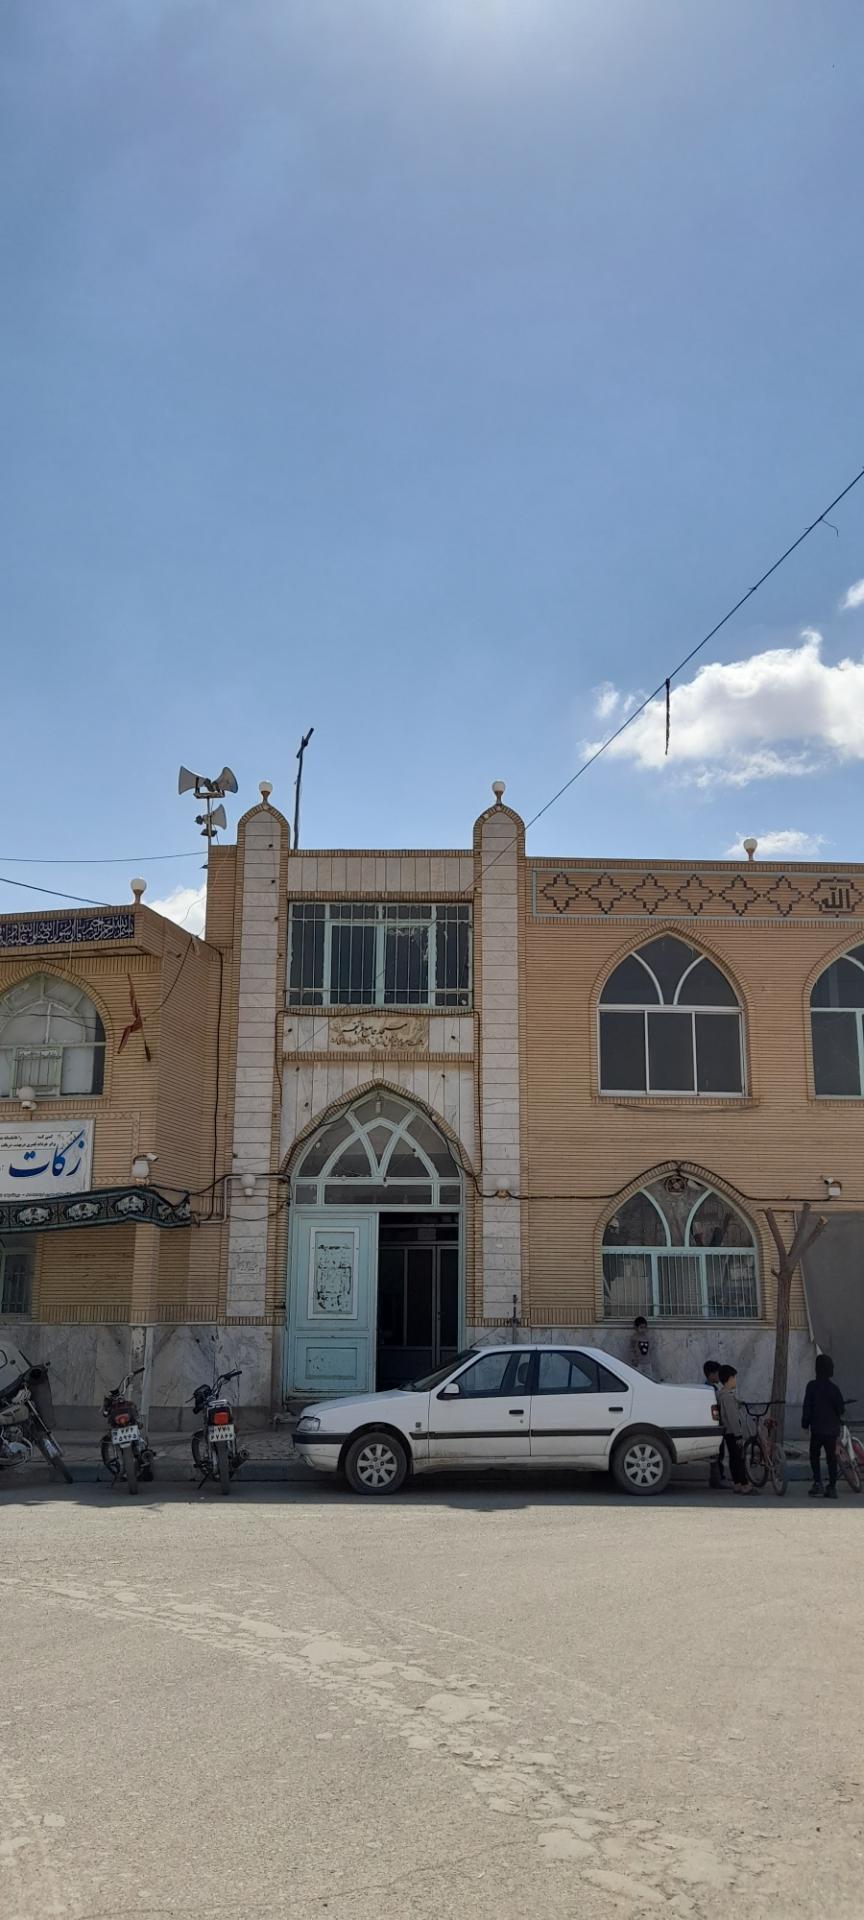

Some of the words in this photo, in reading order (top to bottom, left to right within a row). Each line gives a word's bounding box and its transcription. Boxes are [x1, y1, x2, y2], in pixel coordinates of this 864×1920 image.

[821, 886, 850, 908] الله
[377, 1023, 408, 1036] مسجد
[9, 1129, 84, 1178] زکات
